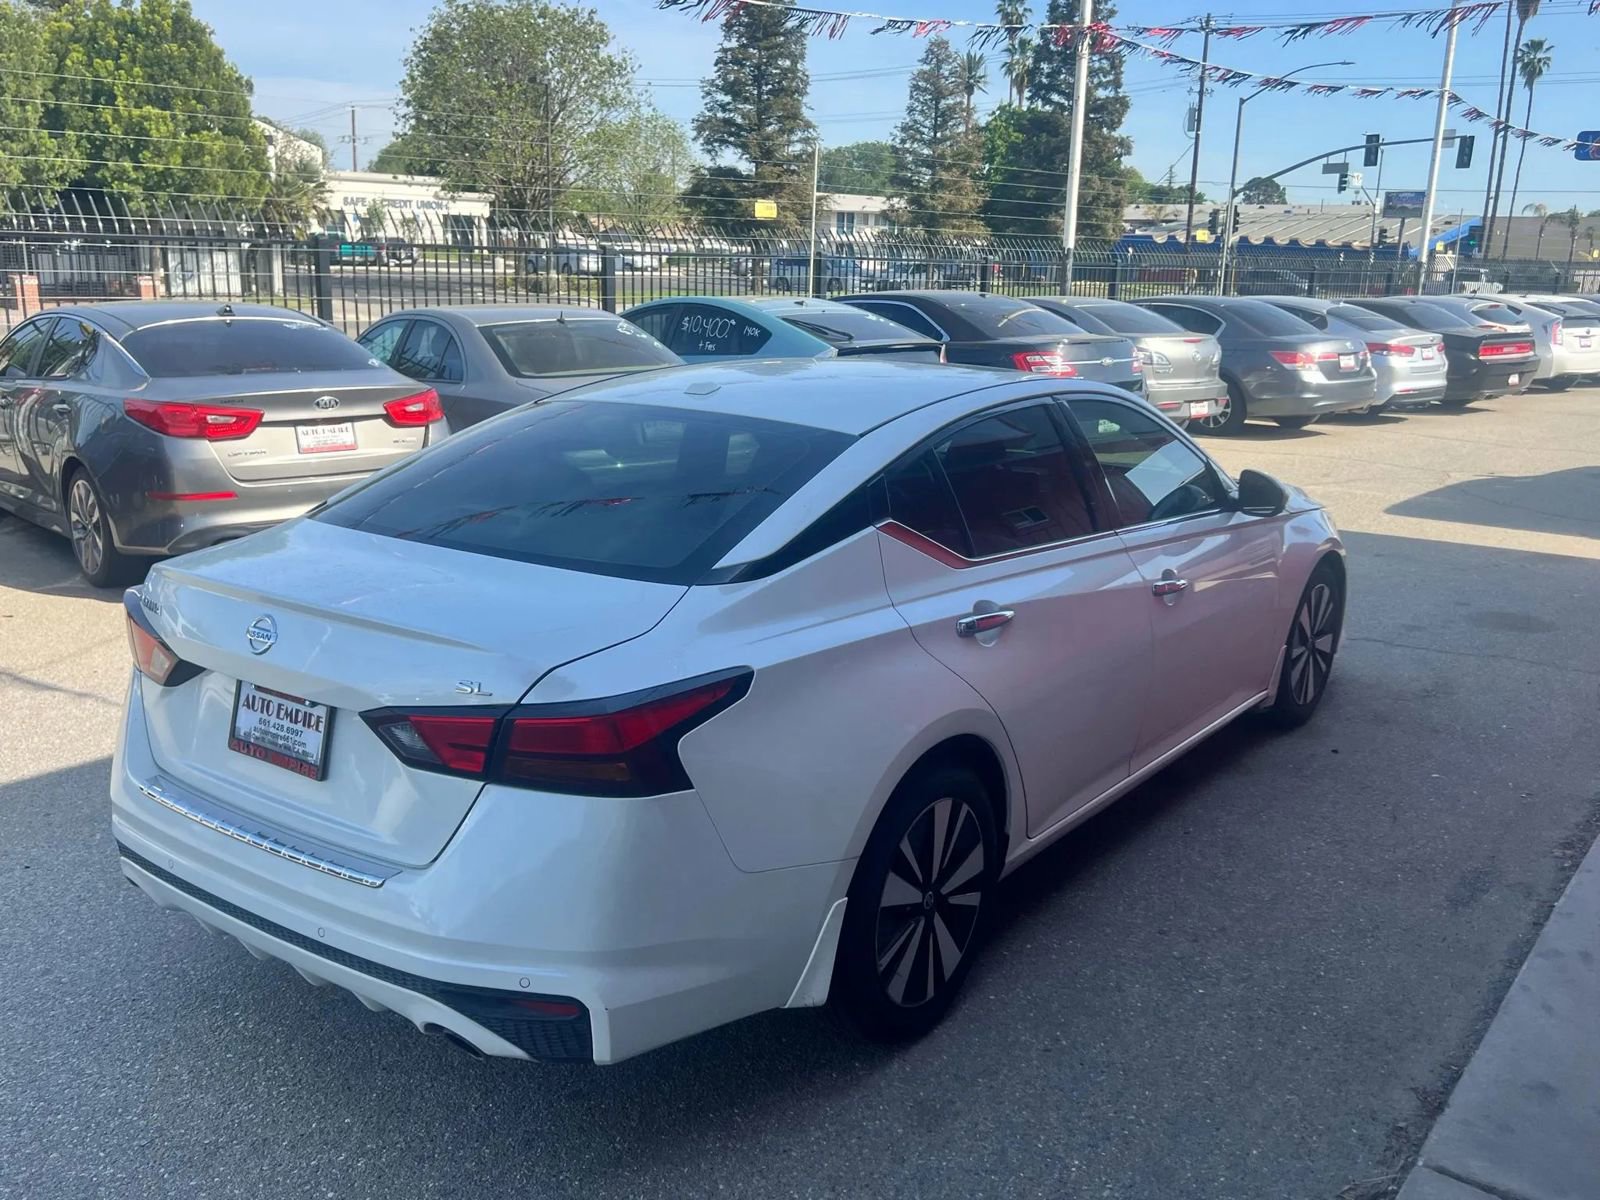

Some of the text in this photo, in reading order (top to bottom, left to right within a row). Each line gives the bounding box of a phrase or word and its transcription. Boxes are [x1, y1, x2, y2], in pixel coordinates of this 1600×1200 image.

[247, 630, 273, 642] NISSAN
[455, 680, 493, 697] SL
[242, 693, 324, 733] AUTO EMPIRE
[258, 717, 304, 738] 661.428.6997
